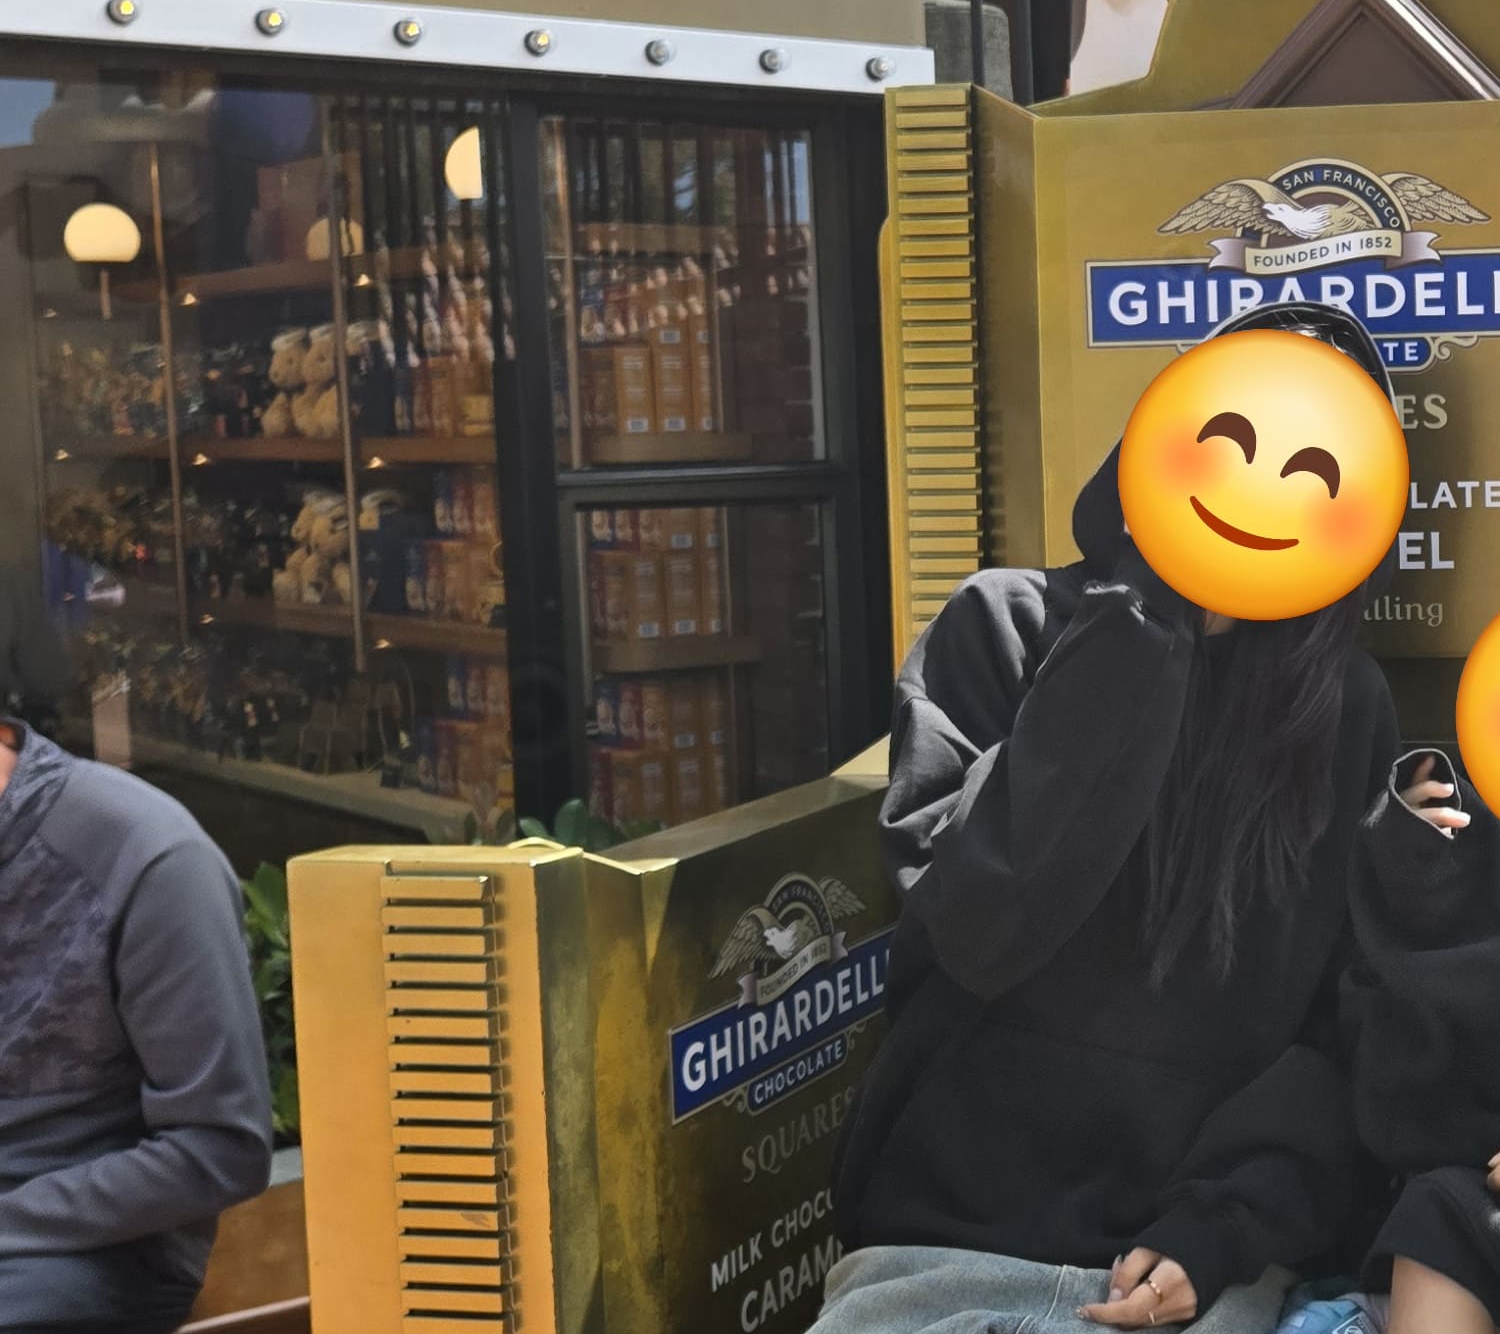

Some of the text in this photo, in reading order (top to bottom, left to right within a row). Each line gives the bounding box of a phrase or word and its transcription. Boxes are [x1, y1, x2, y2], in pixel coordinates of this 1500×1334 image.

[1282, 169, 1401, 228] SAN FRANCISCO
[1253, 236, 1393, 267] FOUNDED IN 1852
[760, 963, 799, 997] FOUNDED
[800, 953, 809, 968] IN
[754, 1039, 843, 1104] CHOCOLATE
[711, 1232, 763, 1292] MILK
[740, 1234, 844, 1334] CARAM
